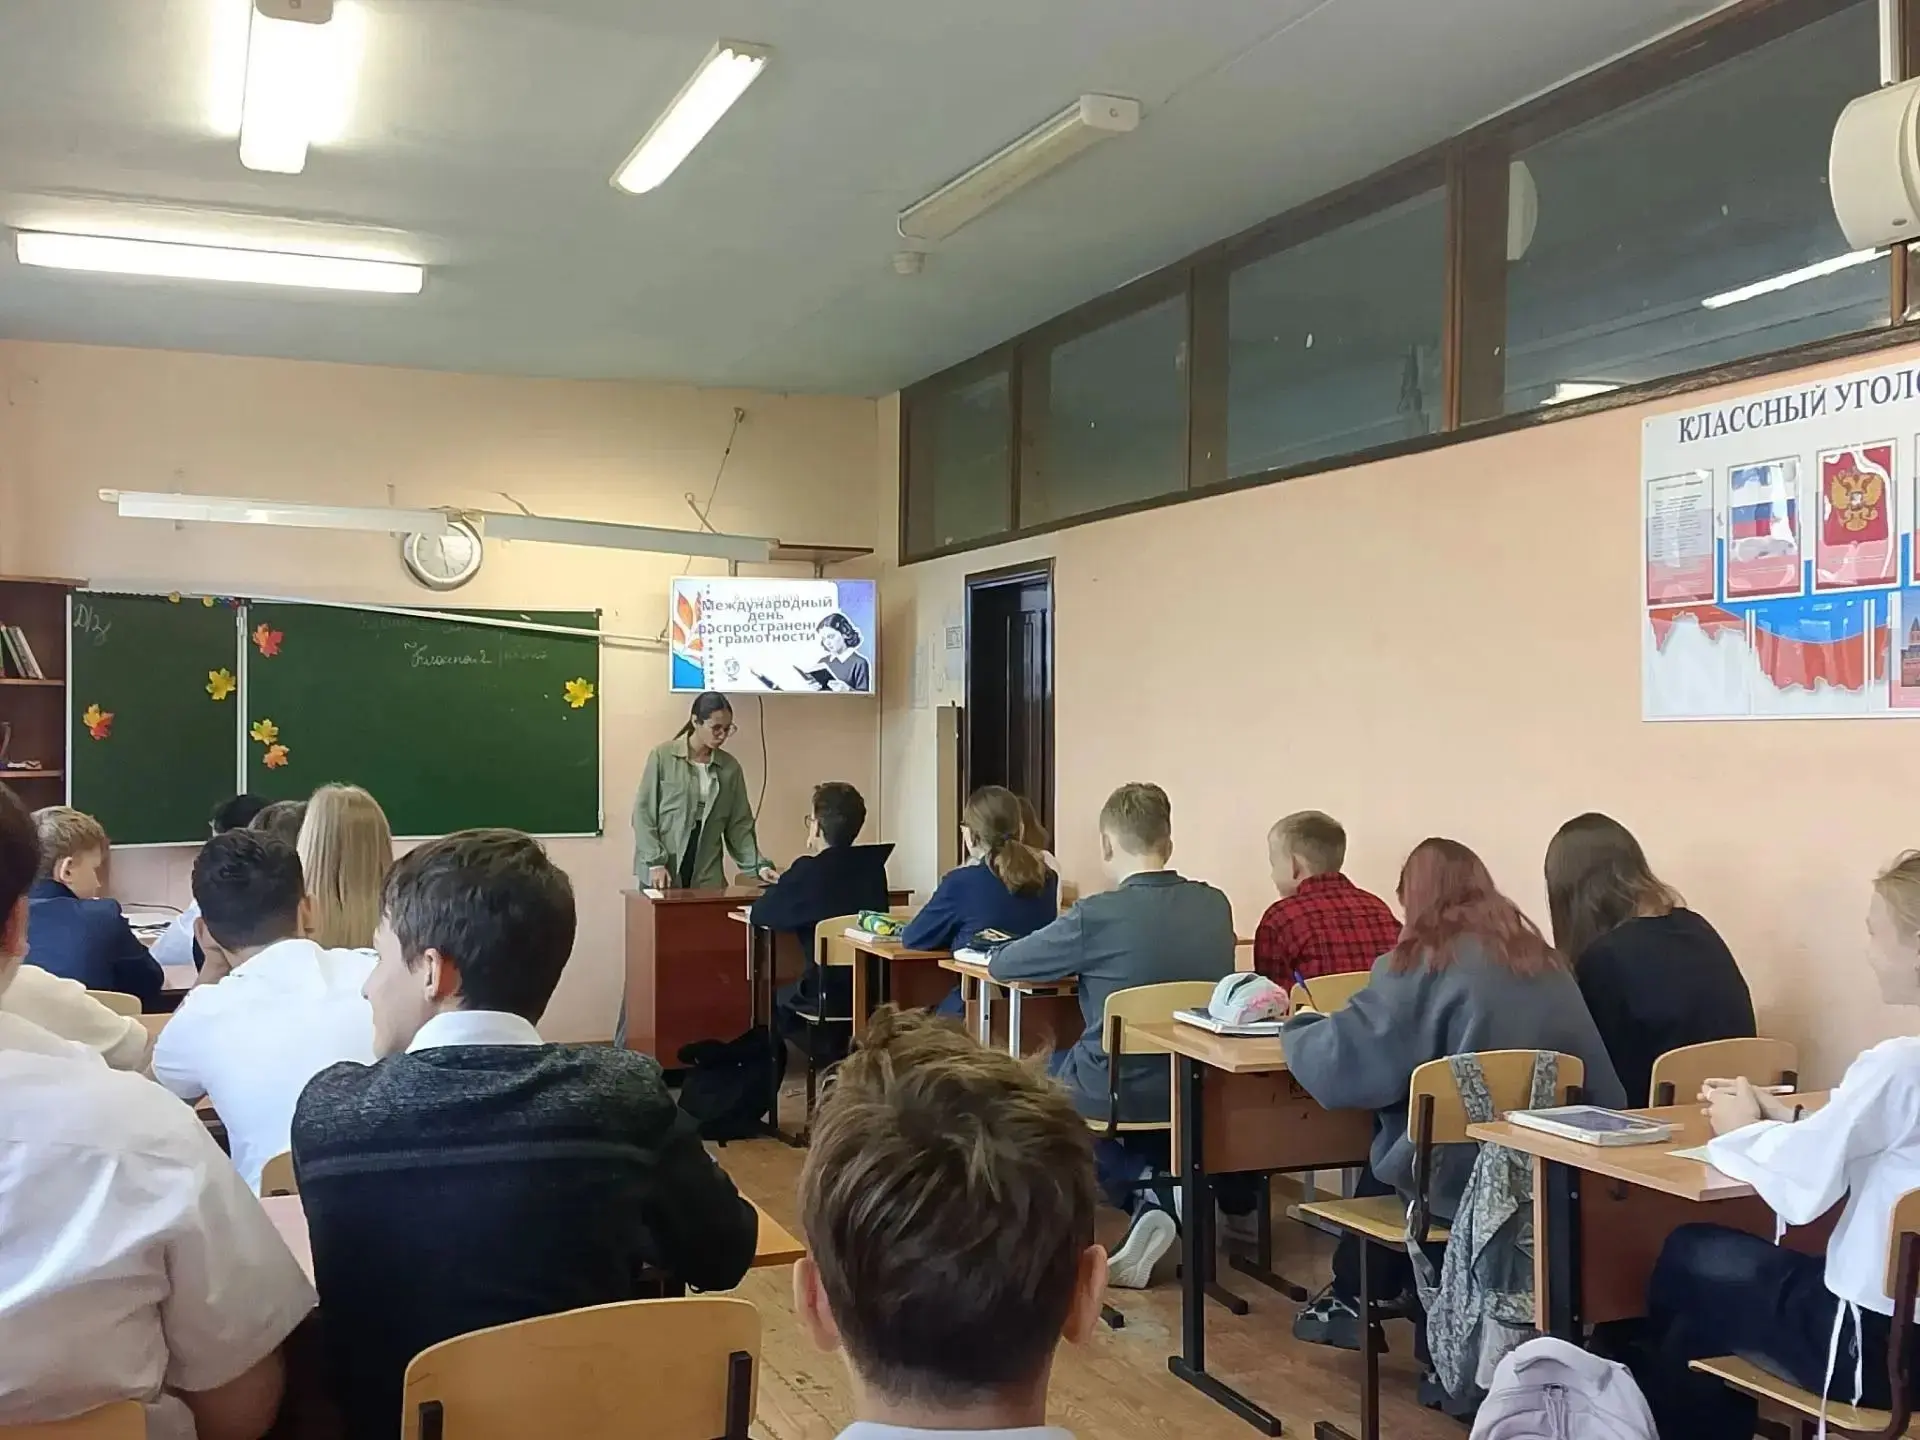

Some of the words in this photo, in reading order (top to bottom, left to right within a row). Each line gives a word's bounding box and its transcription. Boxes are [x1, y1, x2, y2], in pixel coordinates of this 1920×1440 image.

[1679, 384, 1826, 443] КЛАССНЫЙ
[1835, 369, 1920, 412] УГОЛ
[702, 597, 832, 614] Международный
[748, 611, 784, 622] день
[718, 631, 816, 647] грамотности
